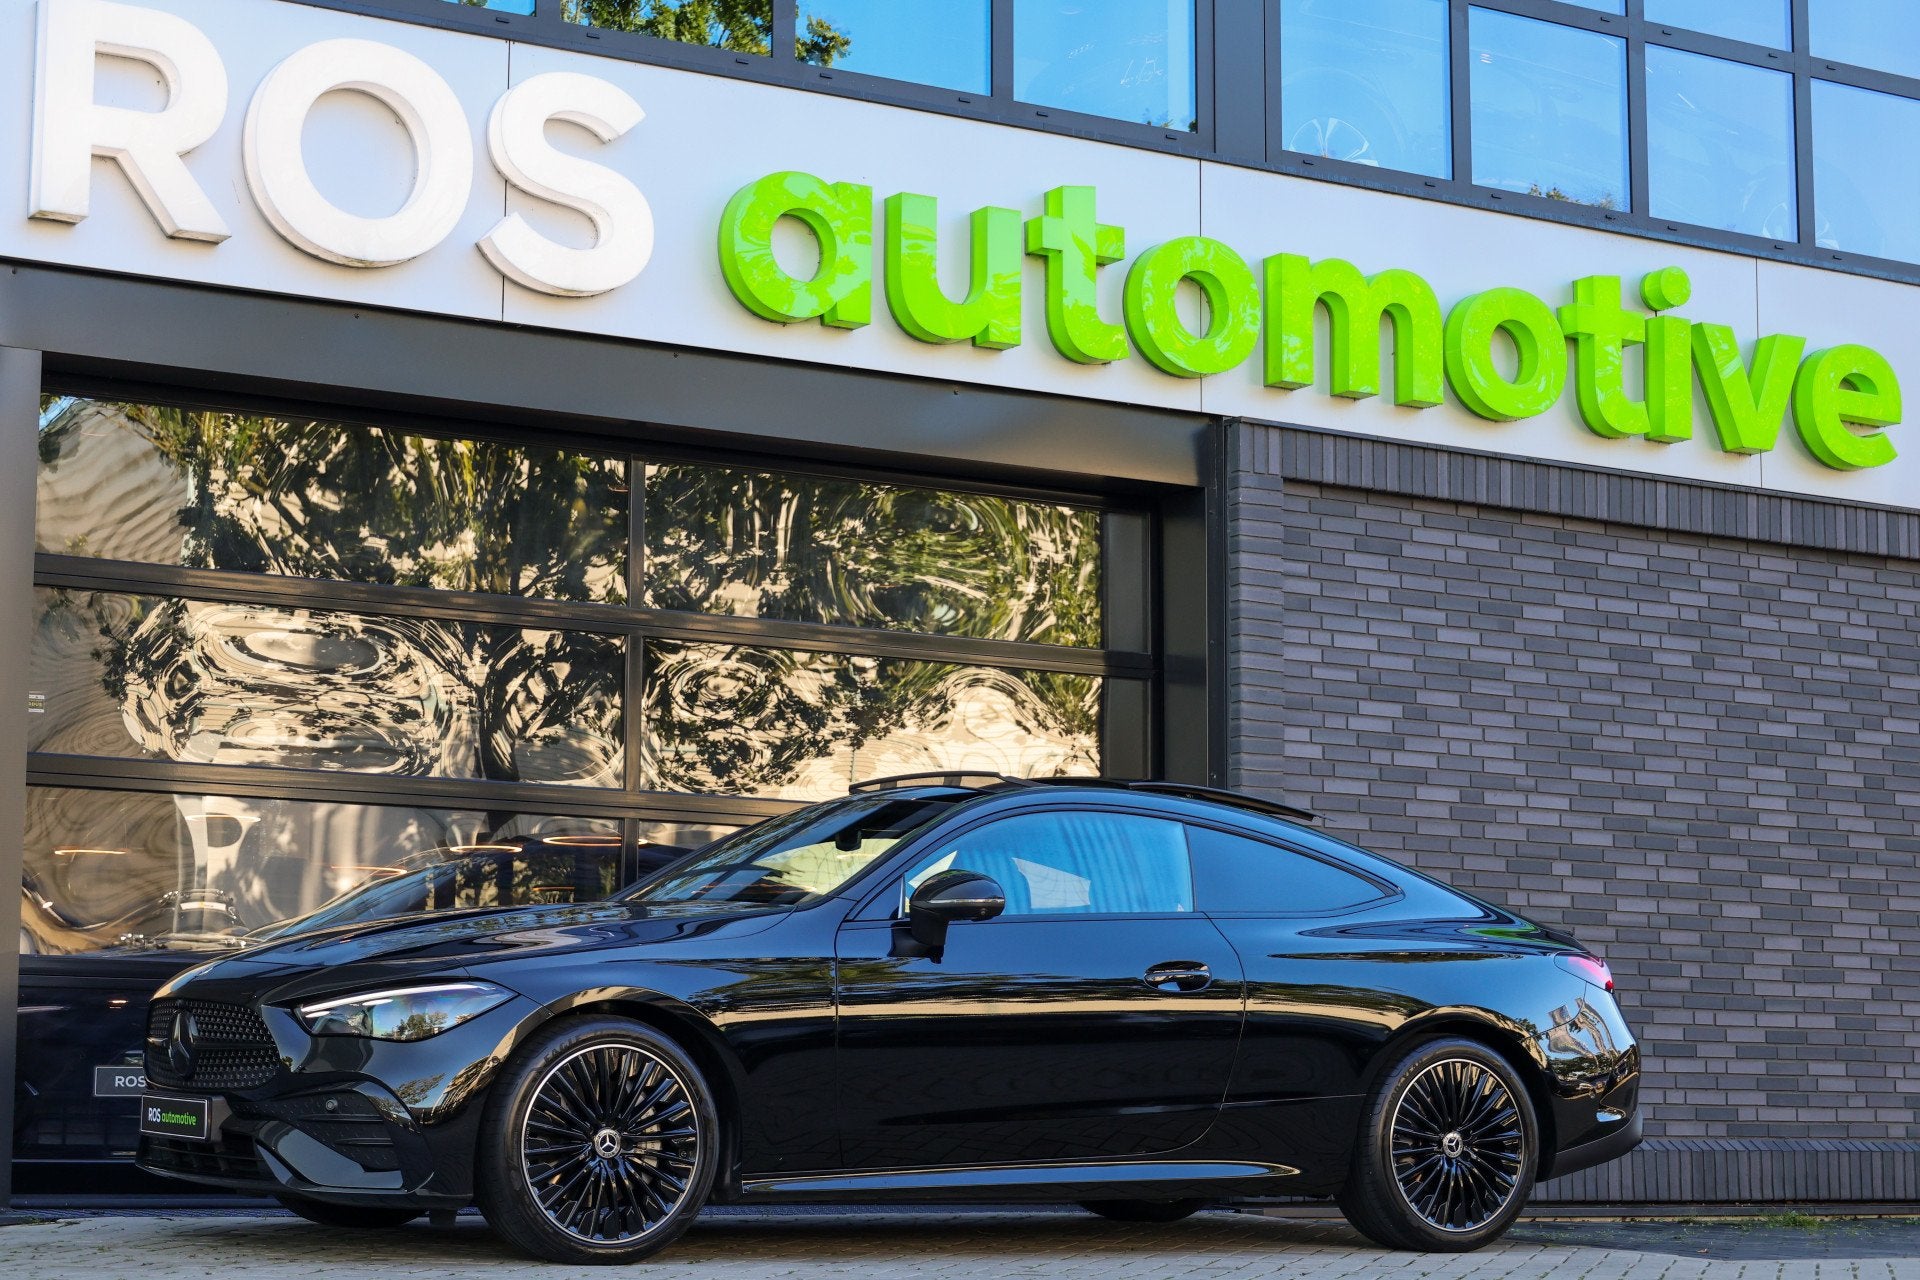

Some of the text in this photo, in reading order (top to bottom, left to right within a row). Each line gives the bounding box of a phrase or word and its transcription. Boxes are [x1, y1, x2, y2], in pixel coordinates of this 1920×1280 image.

[28, 0, 1902, 472] ROS automotive
[115, 1075, 147, 1087] ROS
[148, 1107, 197, 1126] ROS automotive
